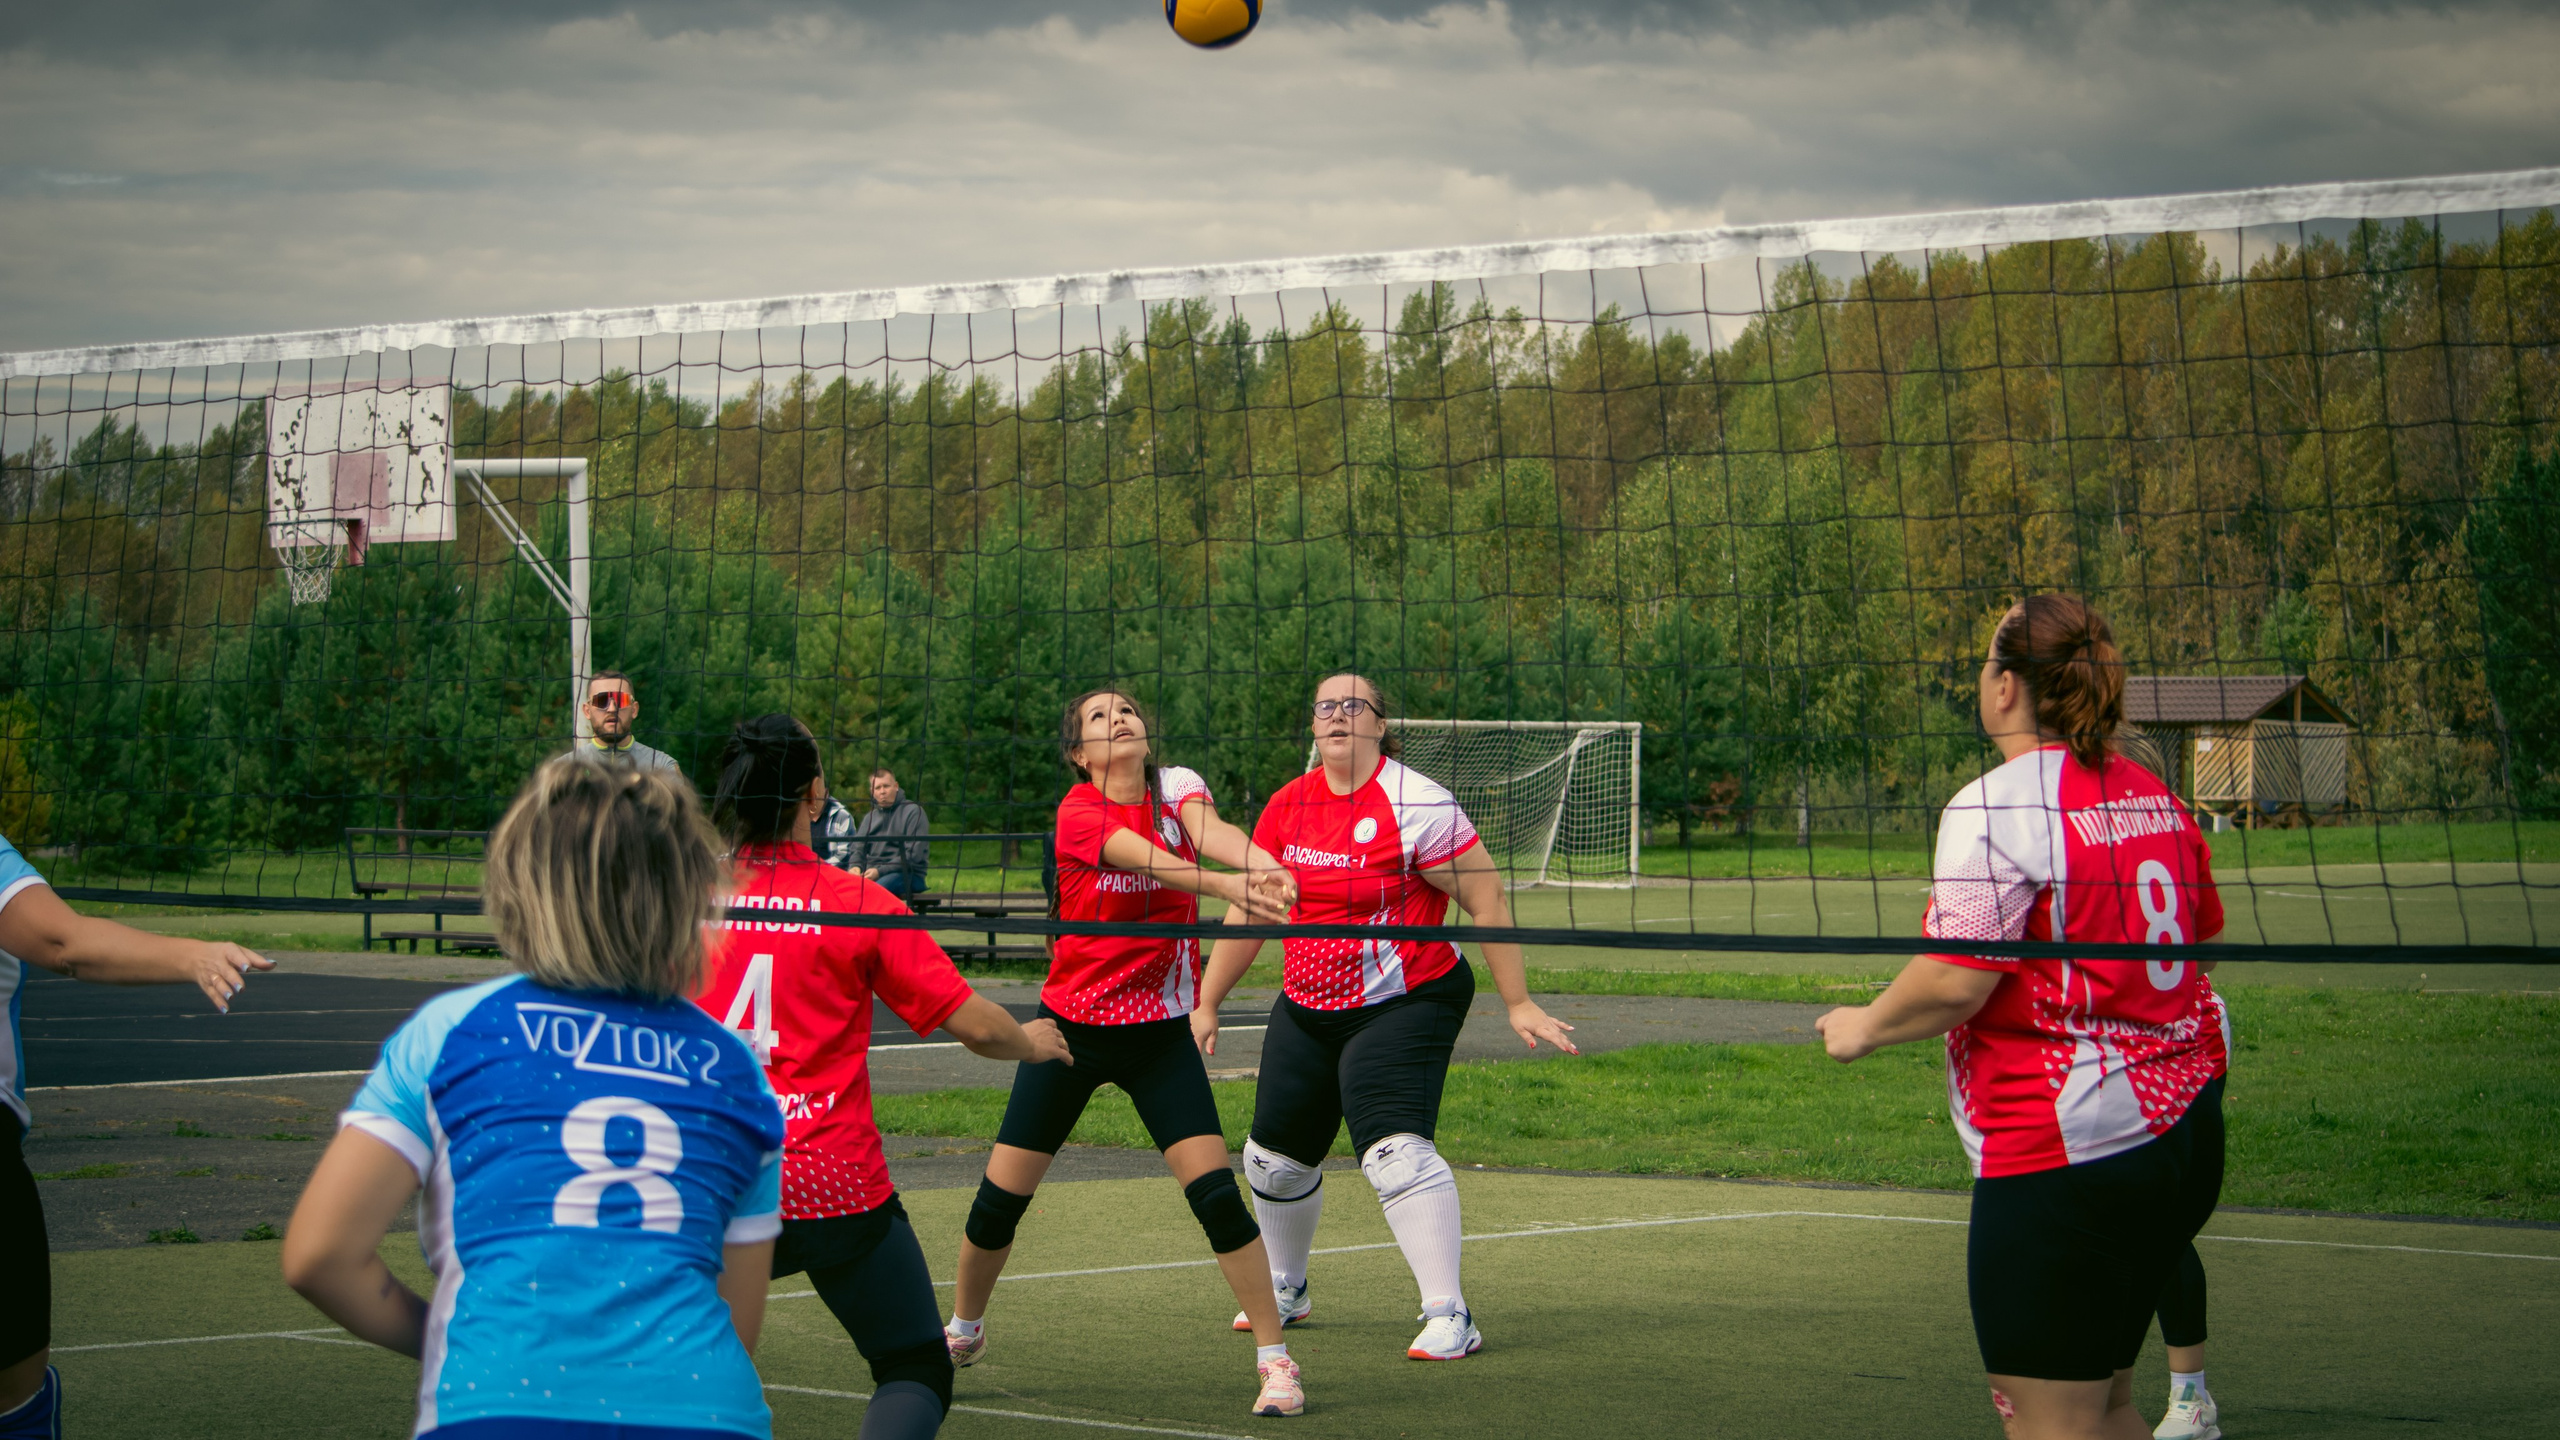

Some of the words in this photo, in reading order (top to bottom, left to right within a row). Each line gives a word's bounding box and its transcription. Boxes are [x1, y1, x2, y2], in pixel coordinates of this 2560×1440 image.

[700, 893, 821, 935] СИПОВА
[2137, 859, 2184, 991] 8
[722, 953, 779, 1066] 4
[552, 1096, 685, 1234] 8
